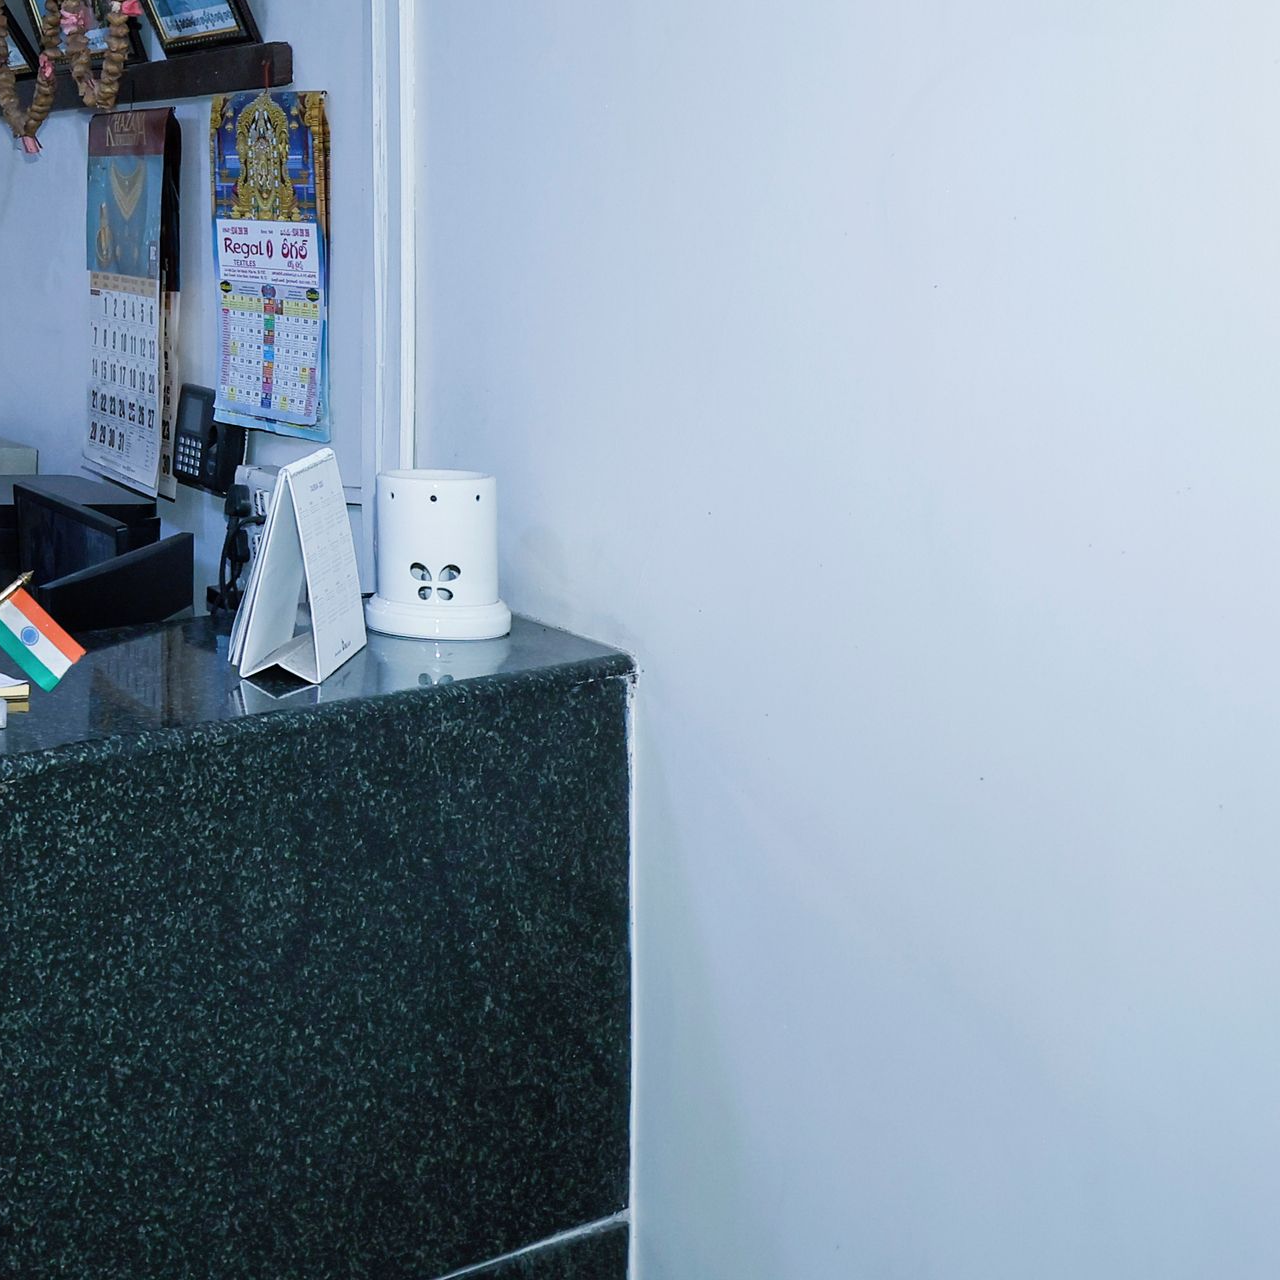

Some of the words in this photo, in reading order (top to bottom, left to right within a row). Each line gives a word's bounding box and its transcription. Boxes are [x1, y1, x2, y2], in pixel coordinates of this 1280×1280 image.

[224, 237, 264, 258] Regal
[233, 259, 256, 267] TEXTILES
[121, 333, 126, 352] 10
[131, 336, 136, 354] 11
[140, 338, 145, 357] 12
[149, 340, 155, 359] 13
[92, 358, 97, 376] 14
[101, 360, 106, 379] 15
[110, 363, 116, 382] 16
[120, 366, 126, 384] 17
[130, 368, 136, 388] 18
[140, 371, 145, 391] 19
[149, 374, 155, 394] 20
[92, 390, 97, 408] 21
[101, 393, 106, 412] 22
[110, 396, 115, 415] 23
[119, 399, 125, 418] 24
[129, 402, 135, 422] 25
[139, 405, 144, 425] 26
[148, 409, 154, 429] 27
[90, 421, 97, 440] 28
[100, 425, 106, 444] 29
[109, 428, 115, 448] 30
[118, 432, 124, 452] 31
